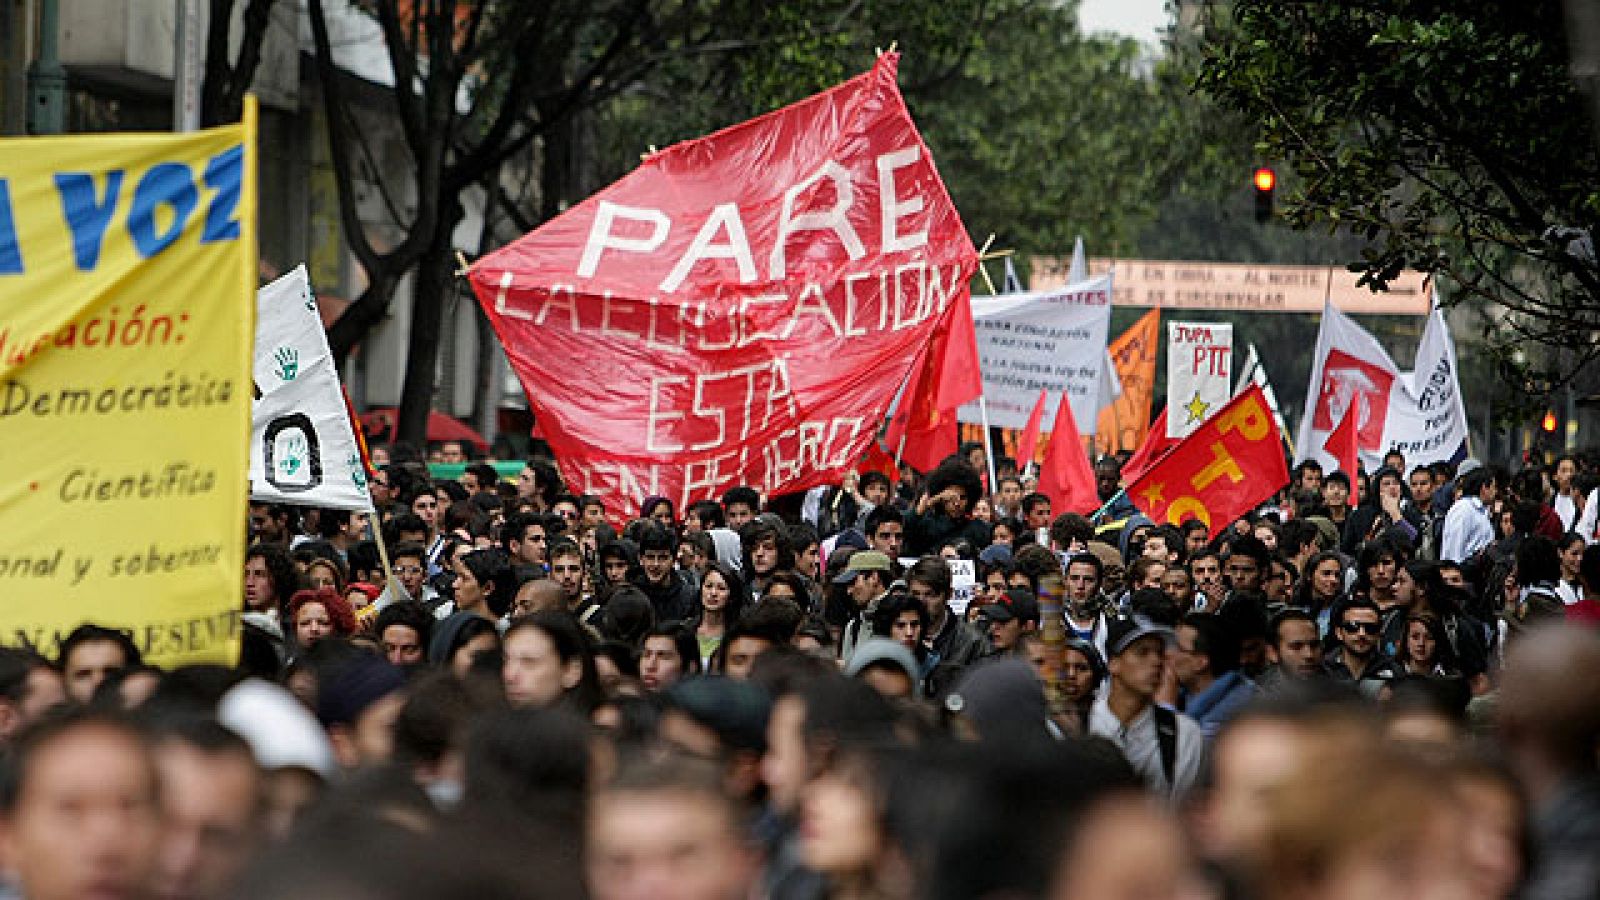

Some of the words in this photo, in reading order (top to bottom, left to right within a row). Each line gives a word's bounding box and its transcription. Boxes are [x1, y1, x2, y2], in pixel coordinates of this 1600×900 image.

[53, 143, 244, 271] VOZ
[577, 145, 930, 293] PARE
[494, 271, 580, 333] LA
